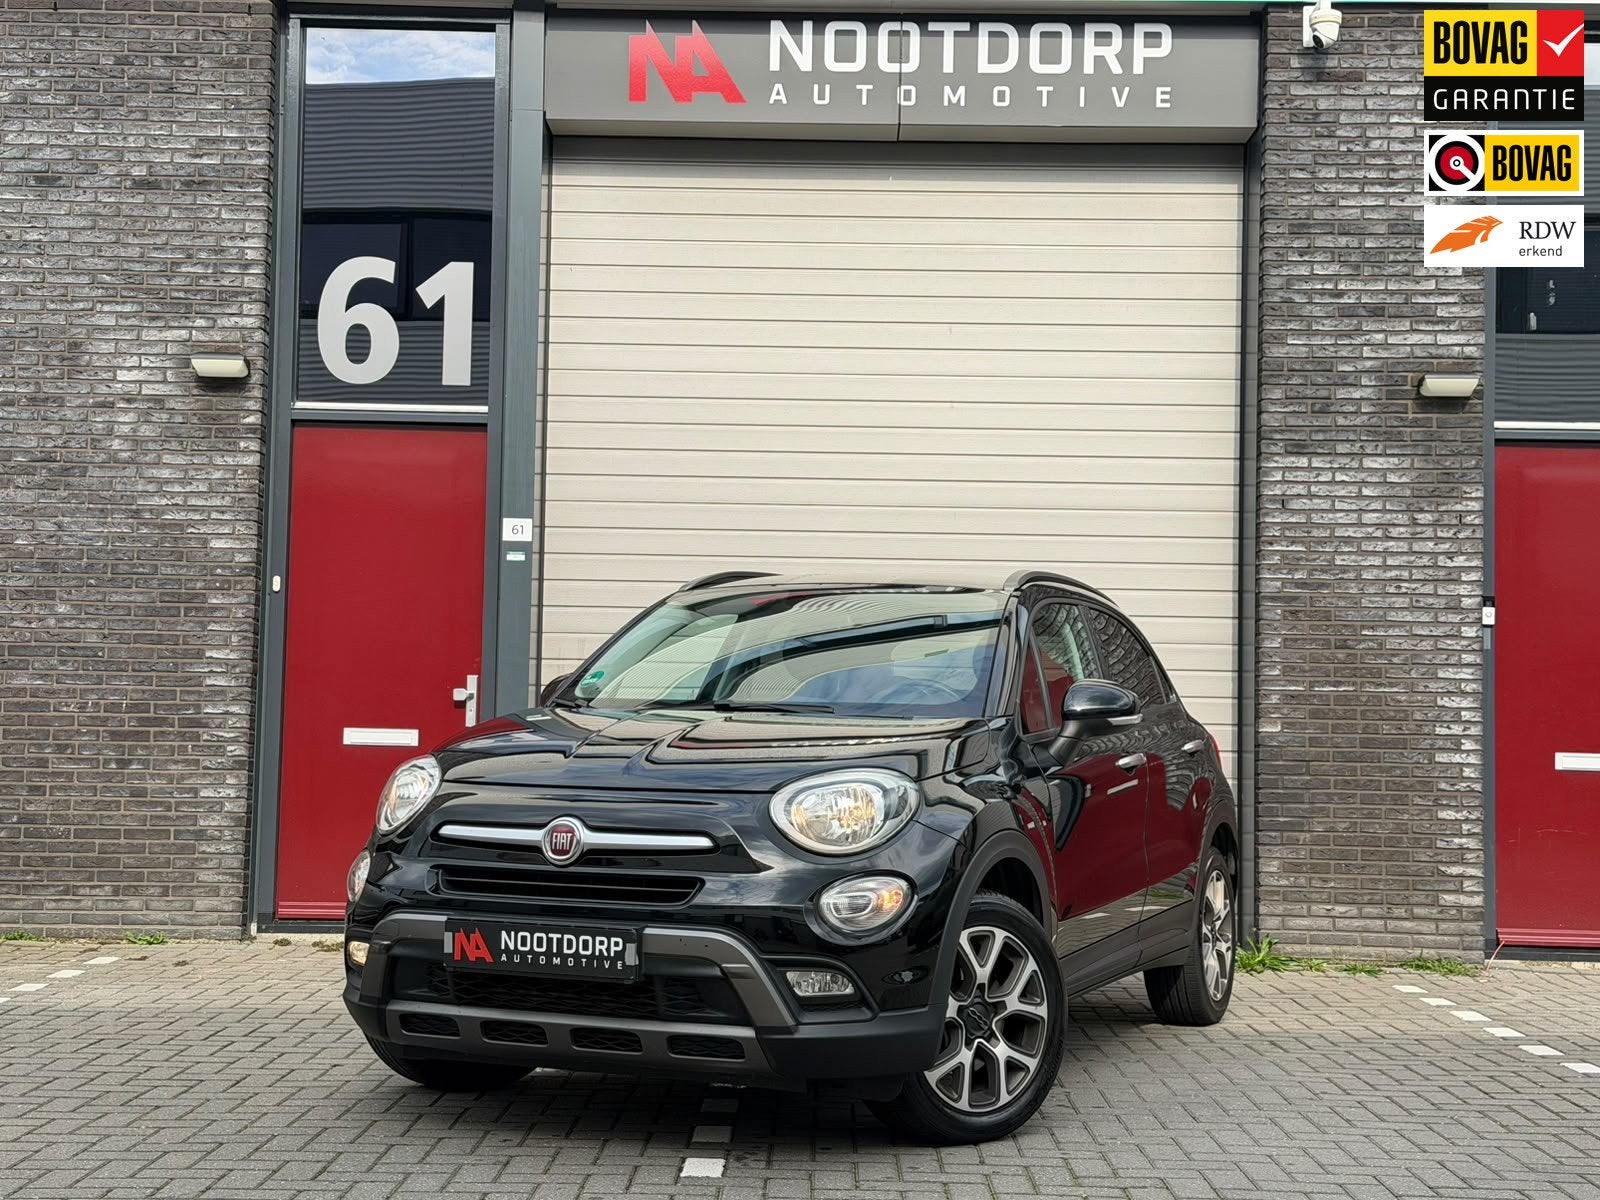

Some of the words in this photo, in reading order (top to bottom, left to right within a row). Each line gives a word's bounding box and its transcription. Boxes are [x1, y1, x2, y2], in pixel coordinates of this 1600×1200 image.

[769, 20, 1173, 75] NOOTDORP
[769, 83, 1173, 108] AUTOMOTIVE
[317, 255, 475, 387] 61
[511, 524, 524, 535] 61
[552, 832, 573, 850] FIAT
[500, 930, 624, 957] NOOTDORP
[500, 953, 624, 970] AUTOMOTIVE
